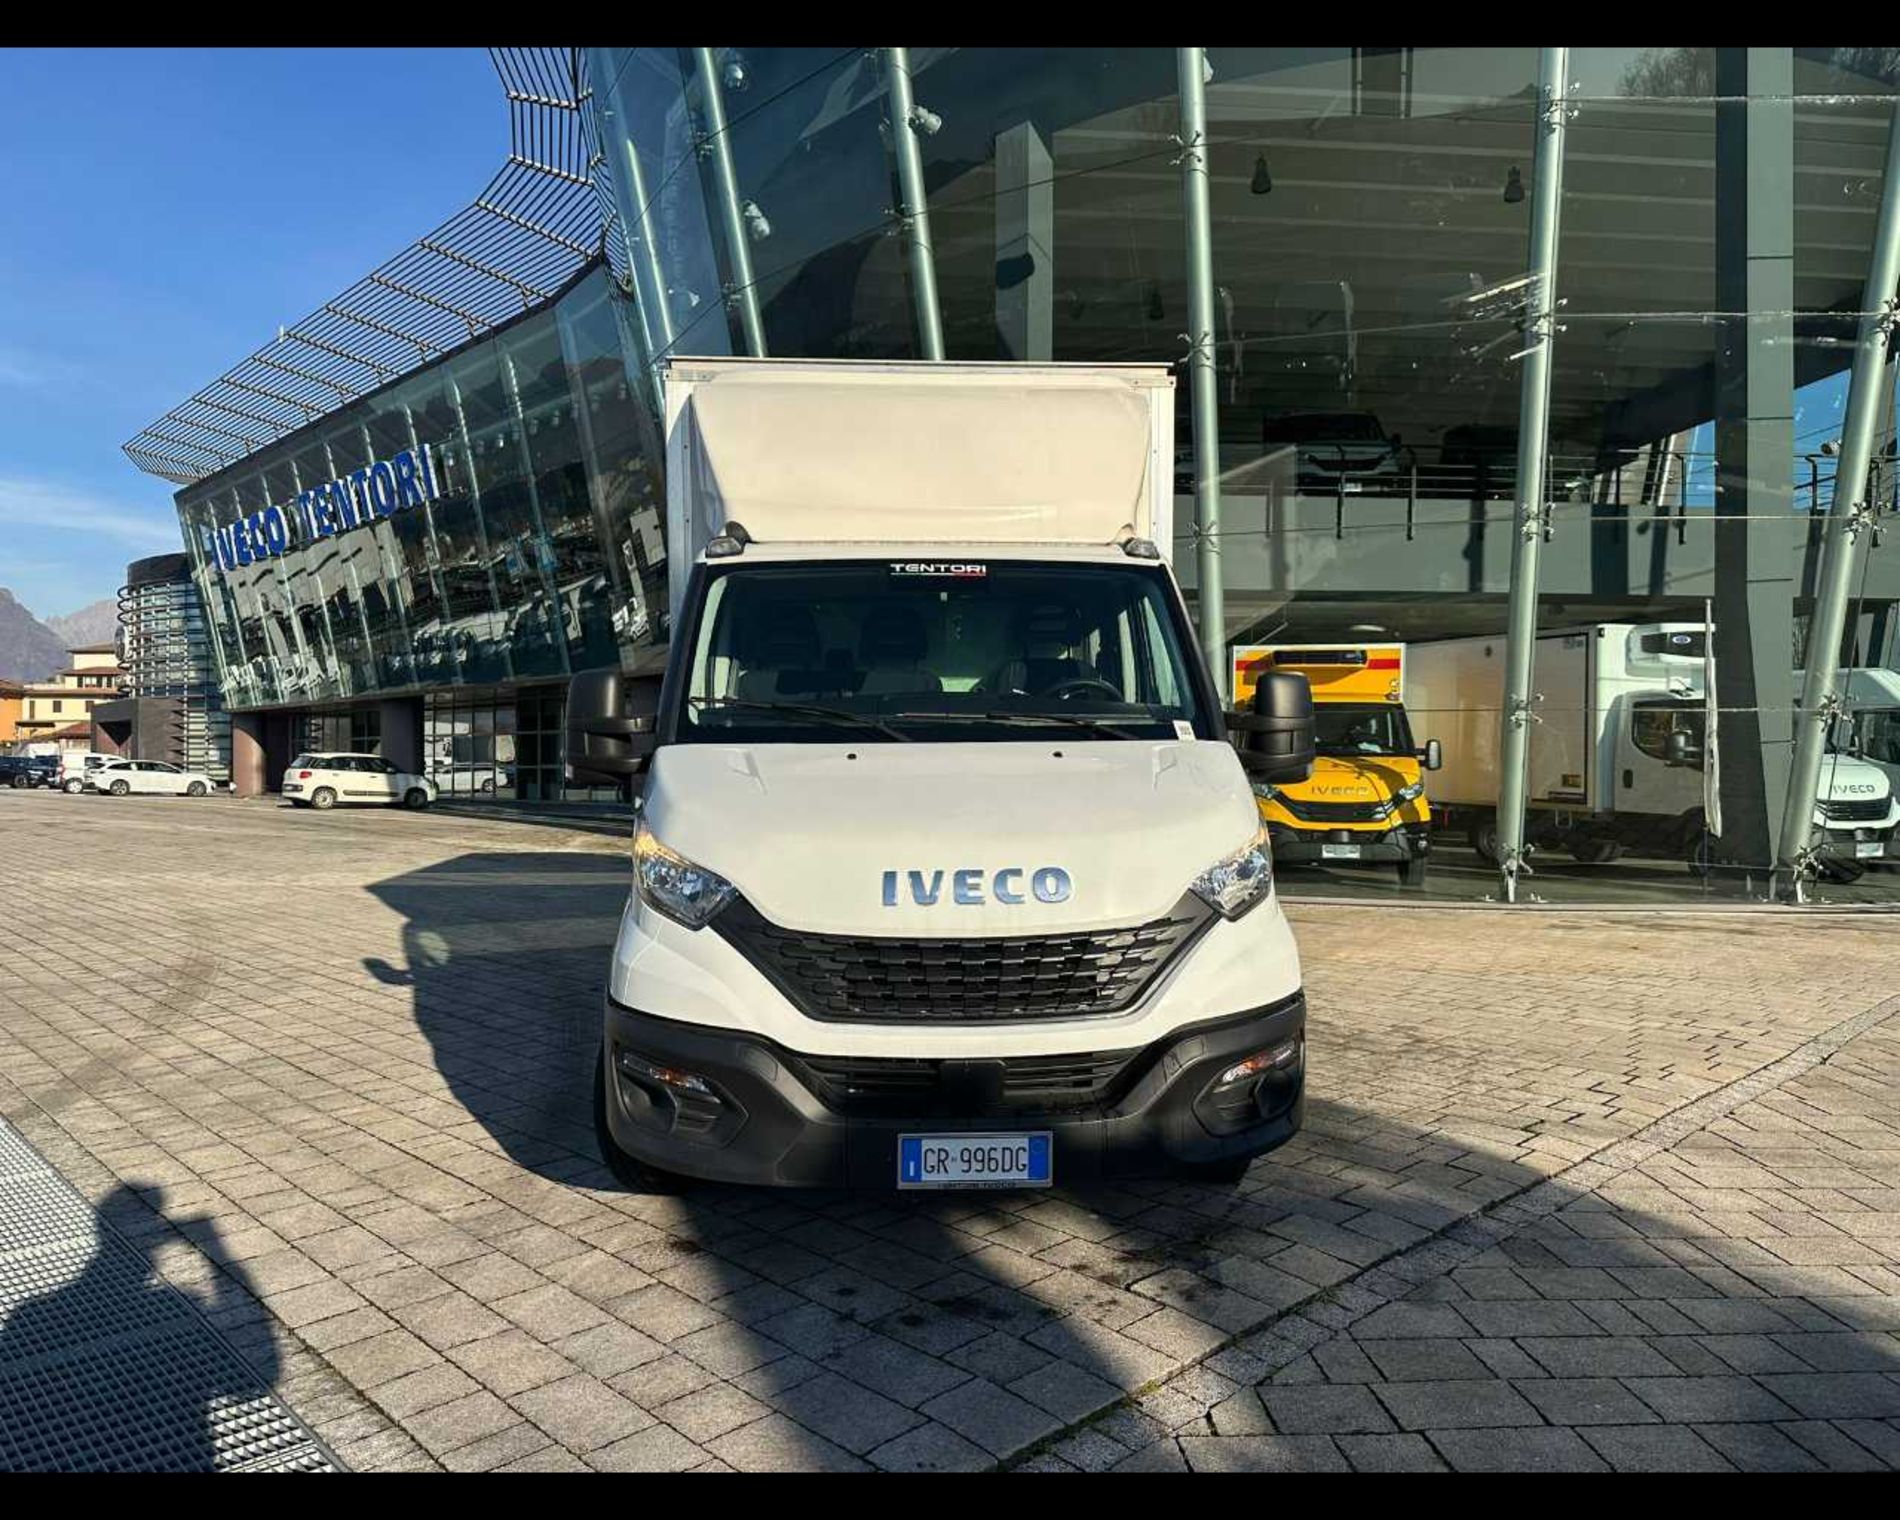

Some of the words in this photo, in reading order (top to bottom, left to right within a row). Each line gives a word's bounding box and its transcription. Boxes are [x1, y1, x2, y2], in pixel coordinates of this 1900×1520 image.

[209, 505, 290, 571] IVECO
[297, 443, 440, 538] TENTORI
[890, 563, 986, 573] TENTORI
[1833, 784, 1876, 794] IVECO
[882, 867, 1072, 906] IVECO
